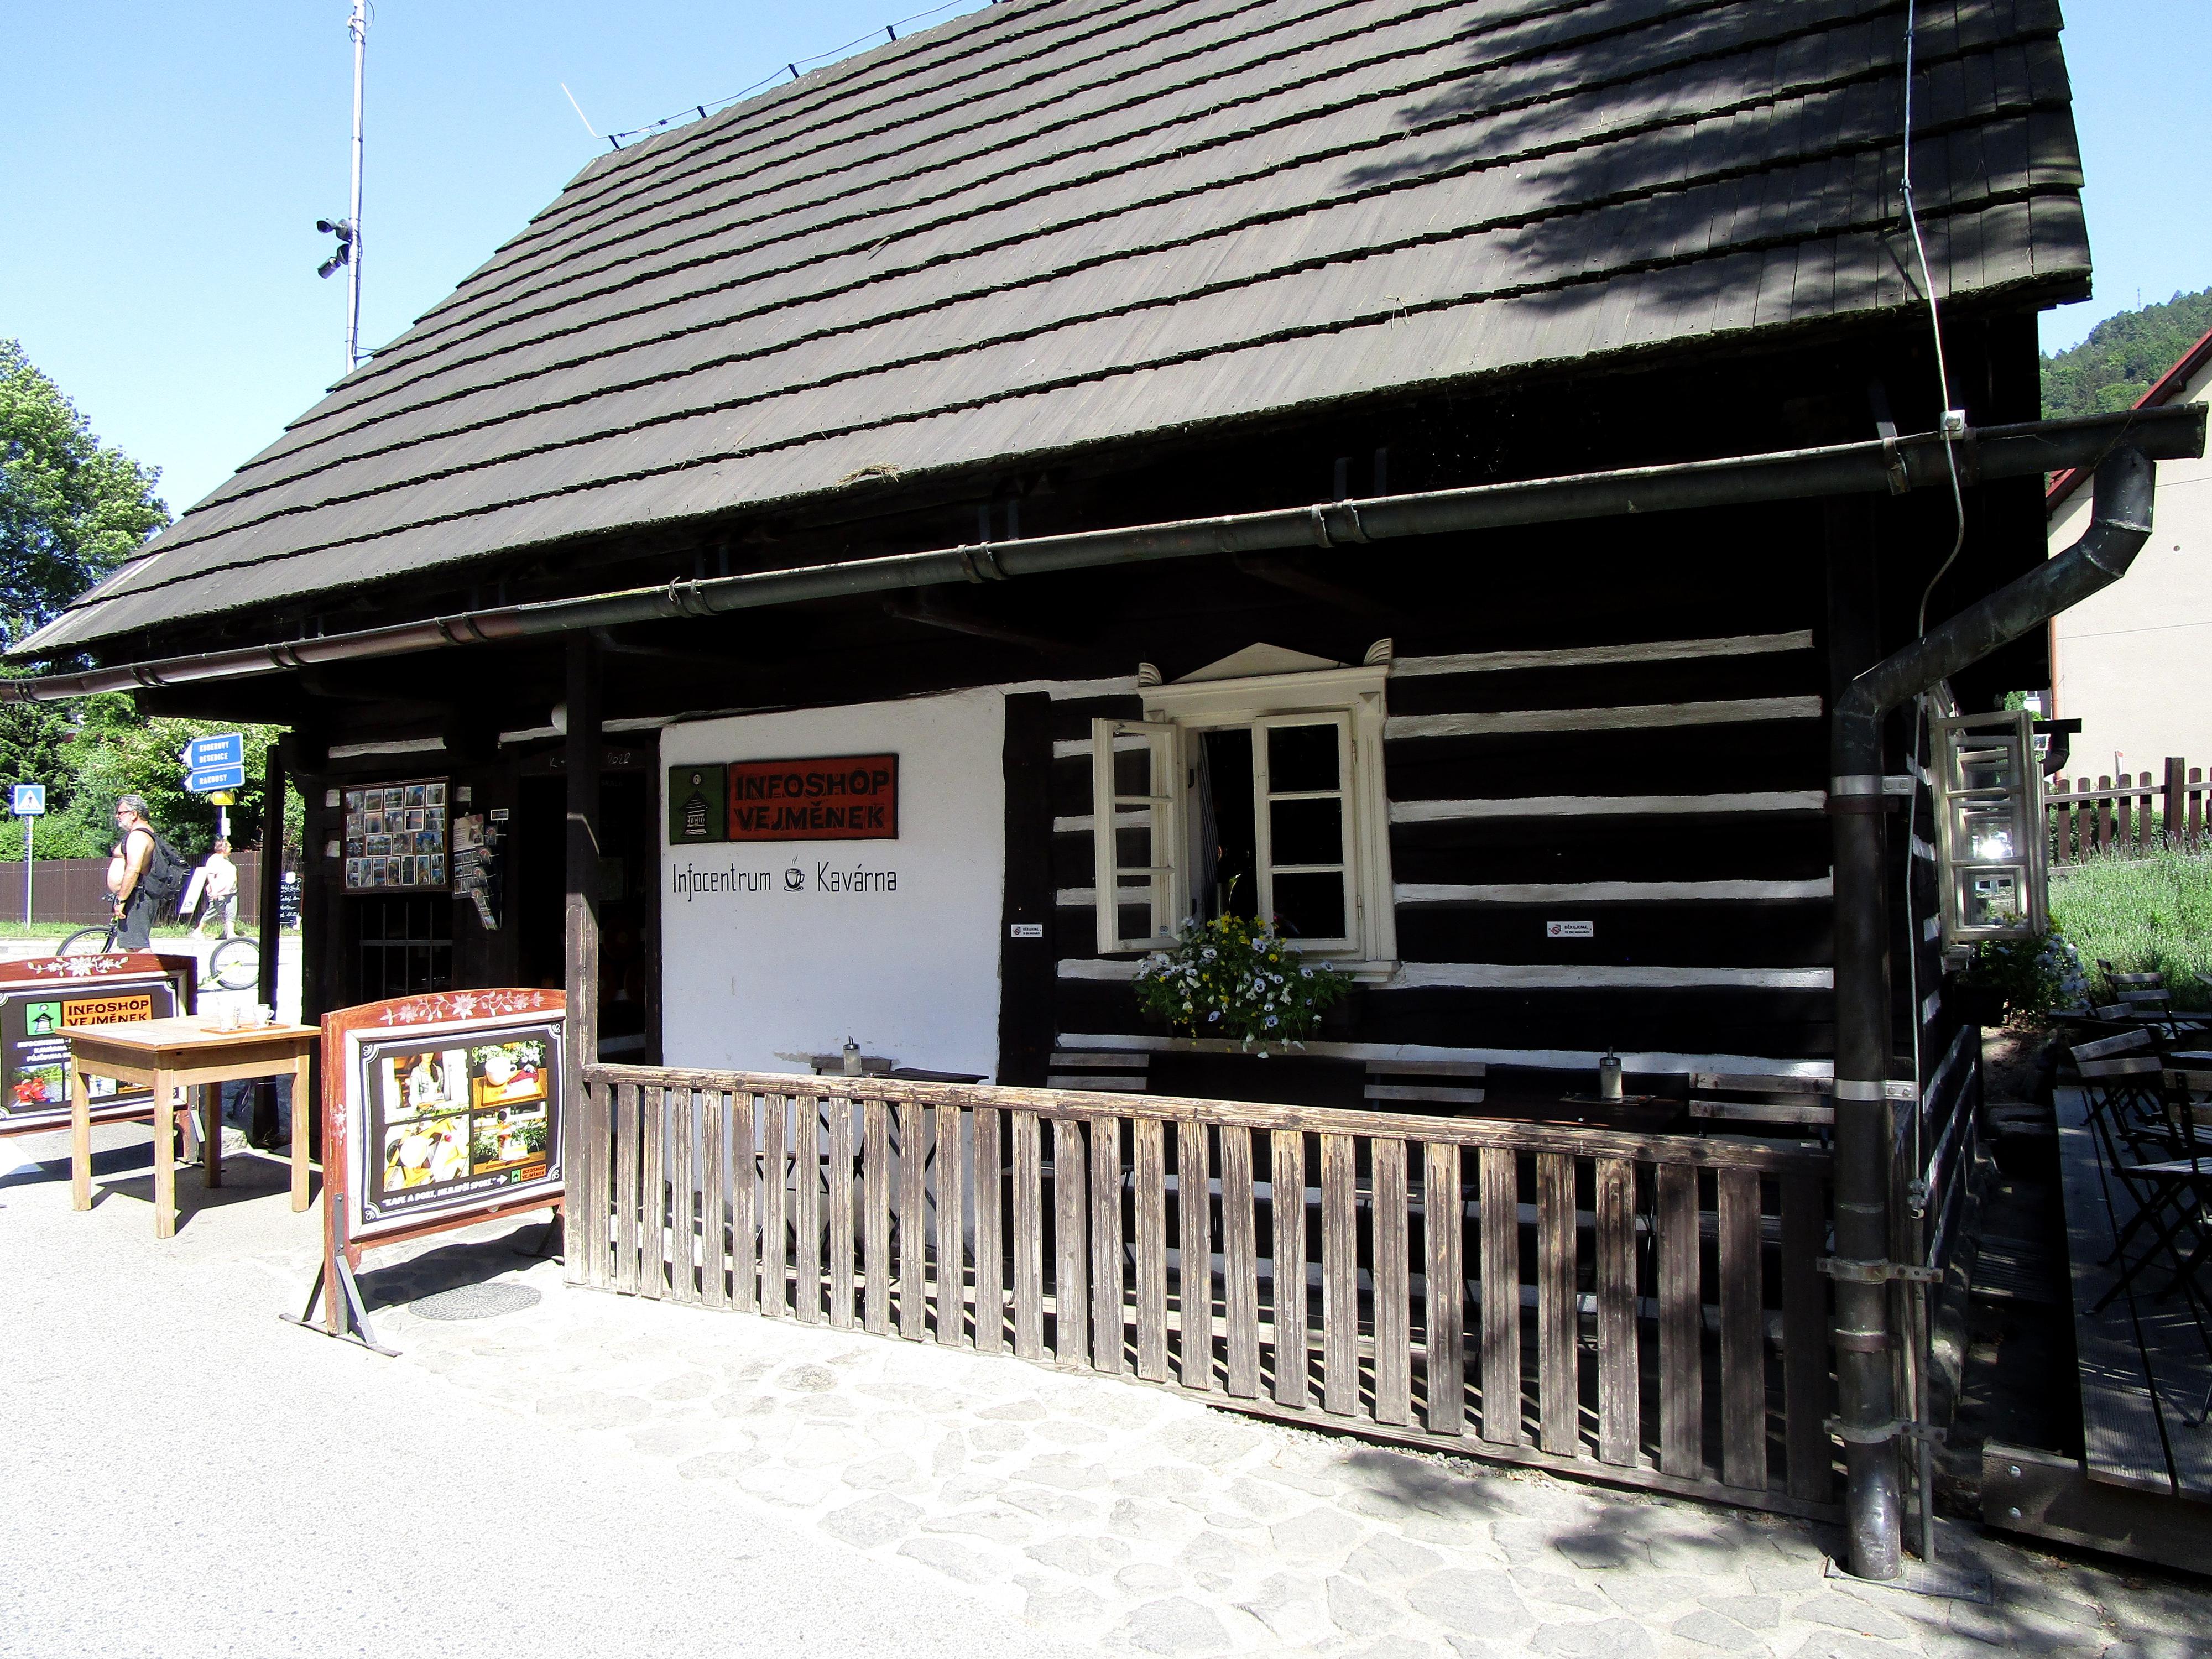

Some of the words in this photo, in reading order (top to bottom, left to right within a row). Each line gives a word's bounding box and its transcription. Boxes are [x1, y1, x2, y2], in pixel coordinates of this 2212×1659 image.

[199, 741, 229, 752] KOBEROVY
[199, 752, 228, 763] BESEDICE
[199, 774, 228, 785] RAKOUSY
[735, 770, 890, 801] INFOSHOP
[734, 801, 885, 830] VEJMĚNEK
[673, 863, 771, 902] Infocentrum
[817, 861, 897, 892] Kavárna
[67, 1000, 149, 1016] INFOSHOP
[406, 1194, 414, 1203] A
